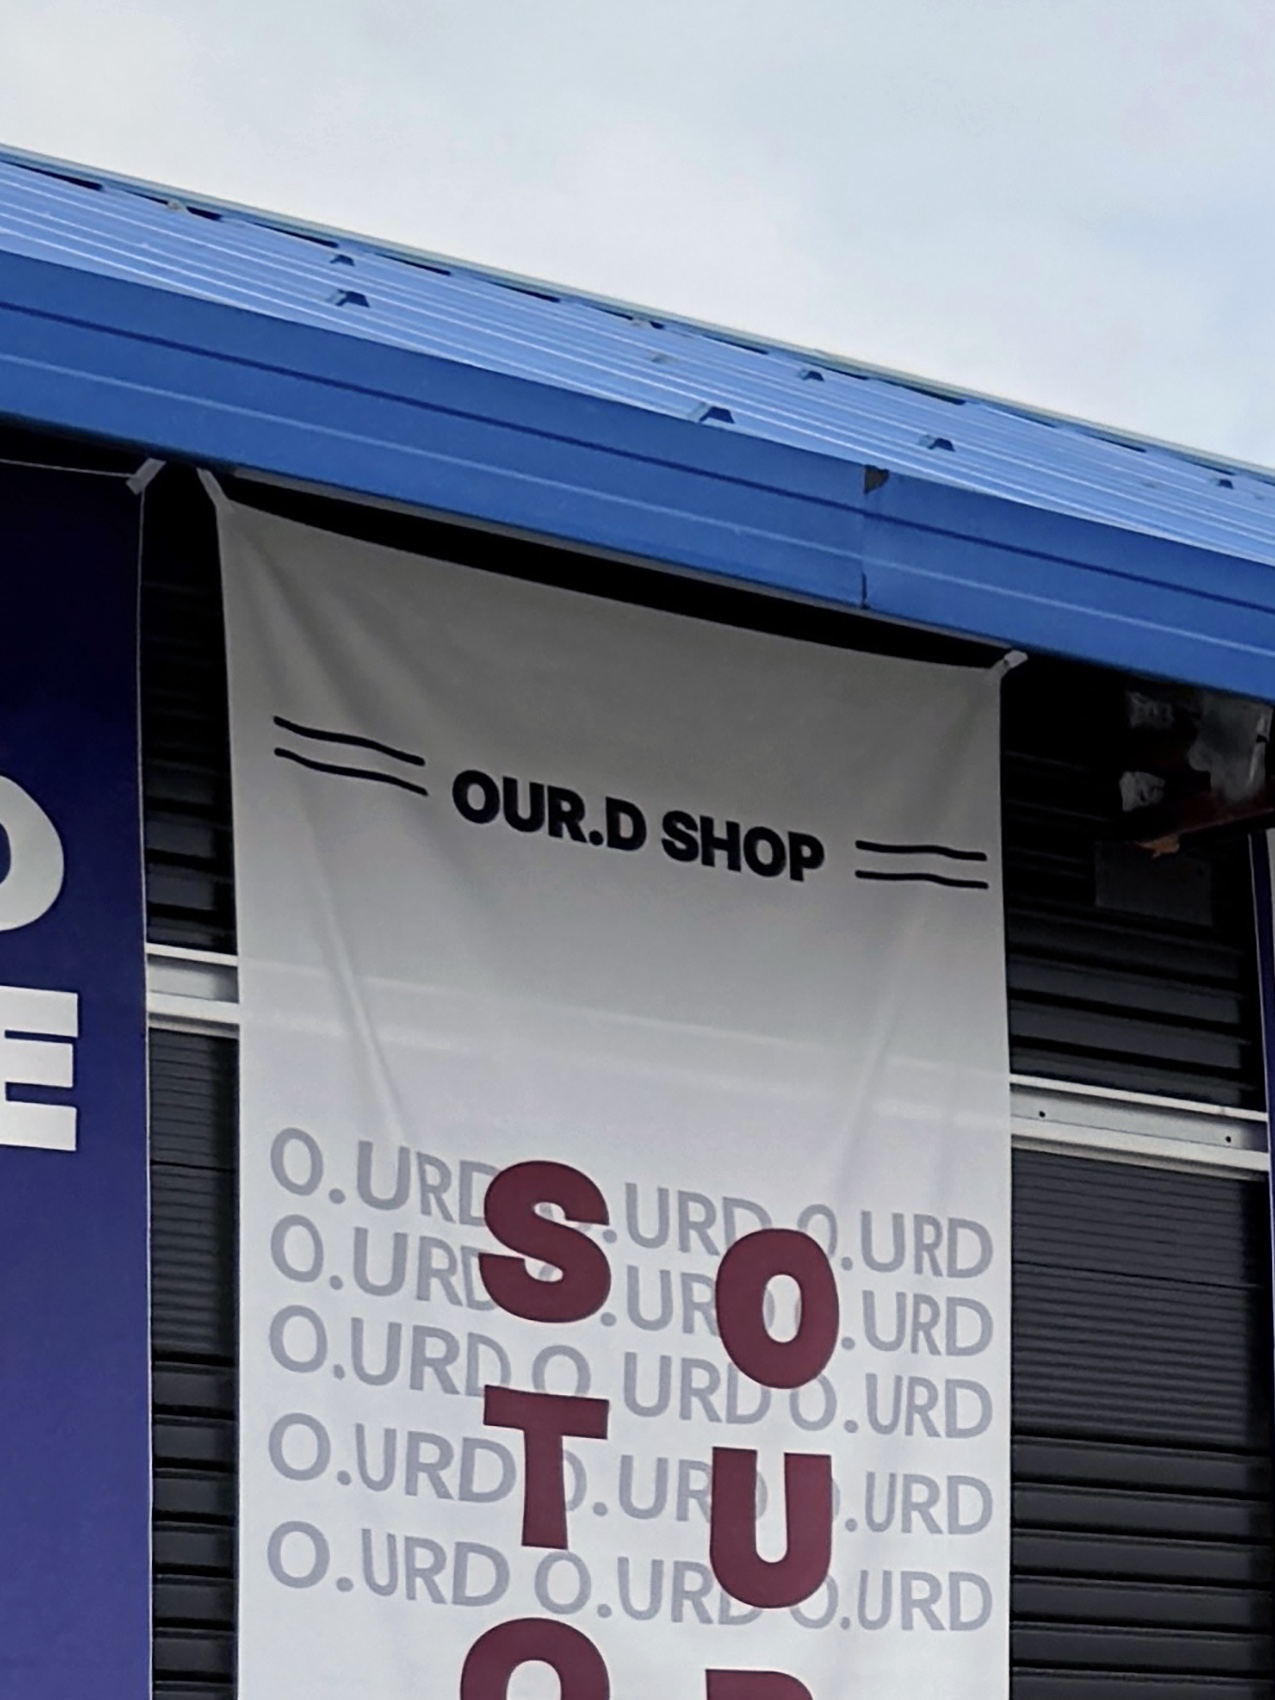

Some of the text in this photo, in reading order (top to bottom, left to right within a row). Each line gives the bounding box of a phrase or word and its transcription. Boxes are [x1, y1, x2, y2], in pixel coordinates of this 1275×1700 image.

[453, 769, 825, 882] OUR.D SHOP
[538, 1181, 773, 1257] .URD
[796, 1289, 994, 1357] .URD
[268, 1412, 517, 1504] O.URD
[831, 1471, 993, 1535] .URD
[267, 1520, 511, 1608] O.URD
